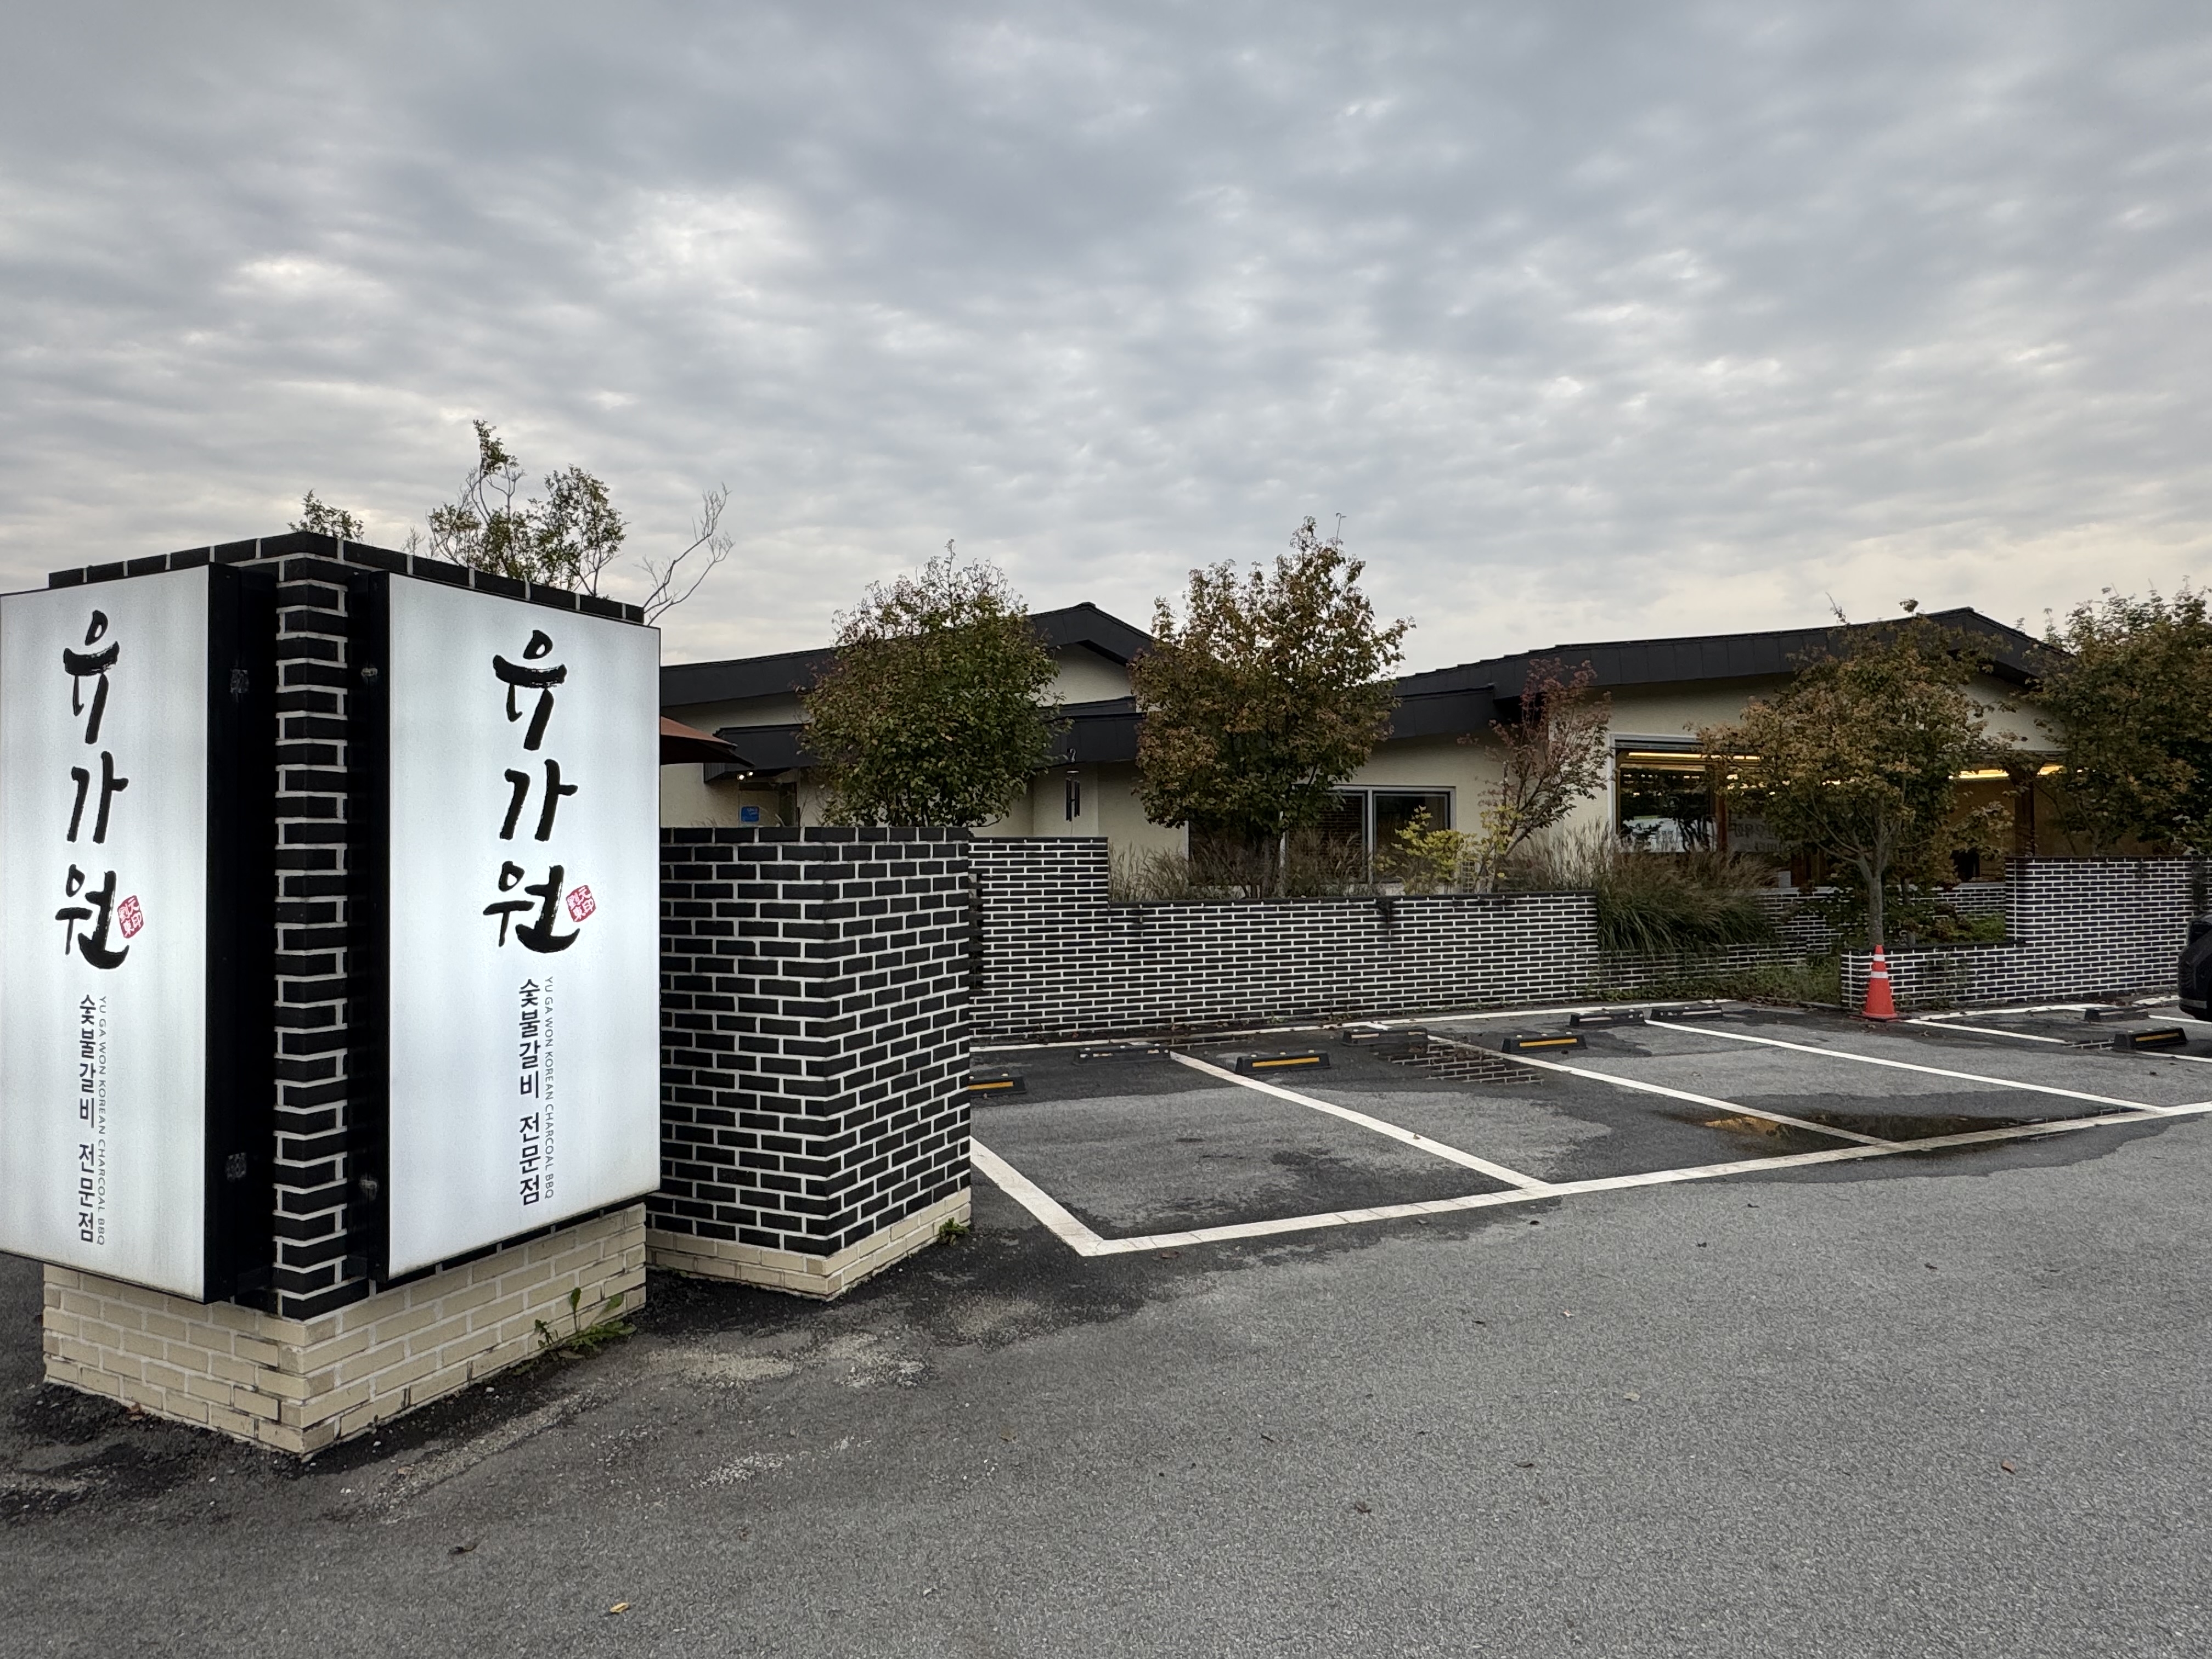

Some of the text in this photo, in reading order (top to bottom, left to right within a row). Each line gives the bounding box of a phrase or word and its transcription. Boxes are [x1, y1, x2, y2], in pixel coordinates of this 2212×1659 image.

[55, 610, 129, 969] 유가원
[483, 630, 580, 953] 유가원
[99, 996, 106, 1014] YU
[99, 1018, 106, 1037] GA
[78, 994, 97, 1243] 숯불갈비 전문점
[98, 1080, 106, 1135] KOREAN
[520, 979, 541, 1206] 숯불갈비 전문점
[544, 976, 554, 1199] YU GA WON KOREAN CHARCOAL BBQ
[97, 1218, 105, 1245] BBQ
[98, 1139, 106, 1212] CHARCOAL
